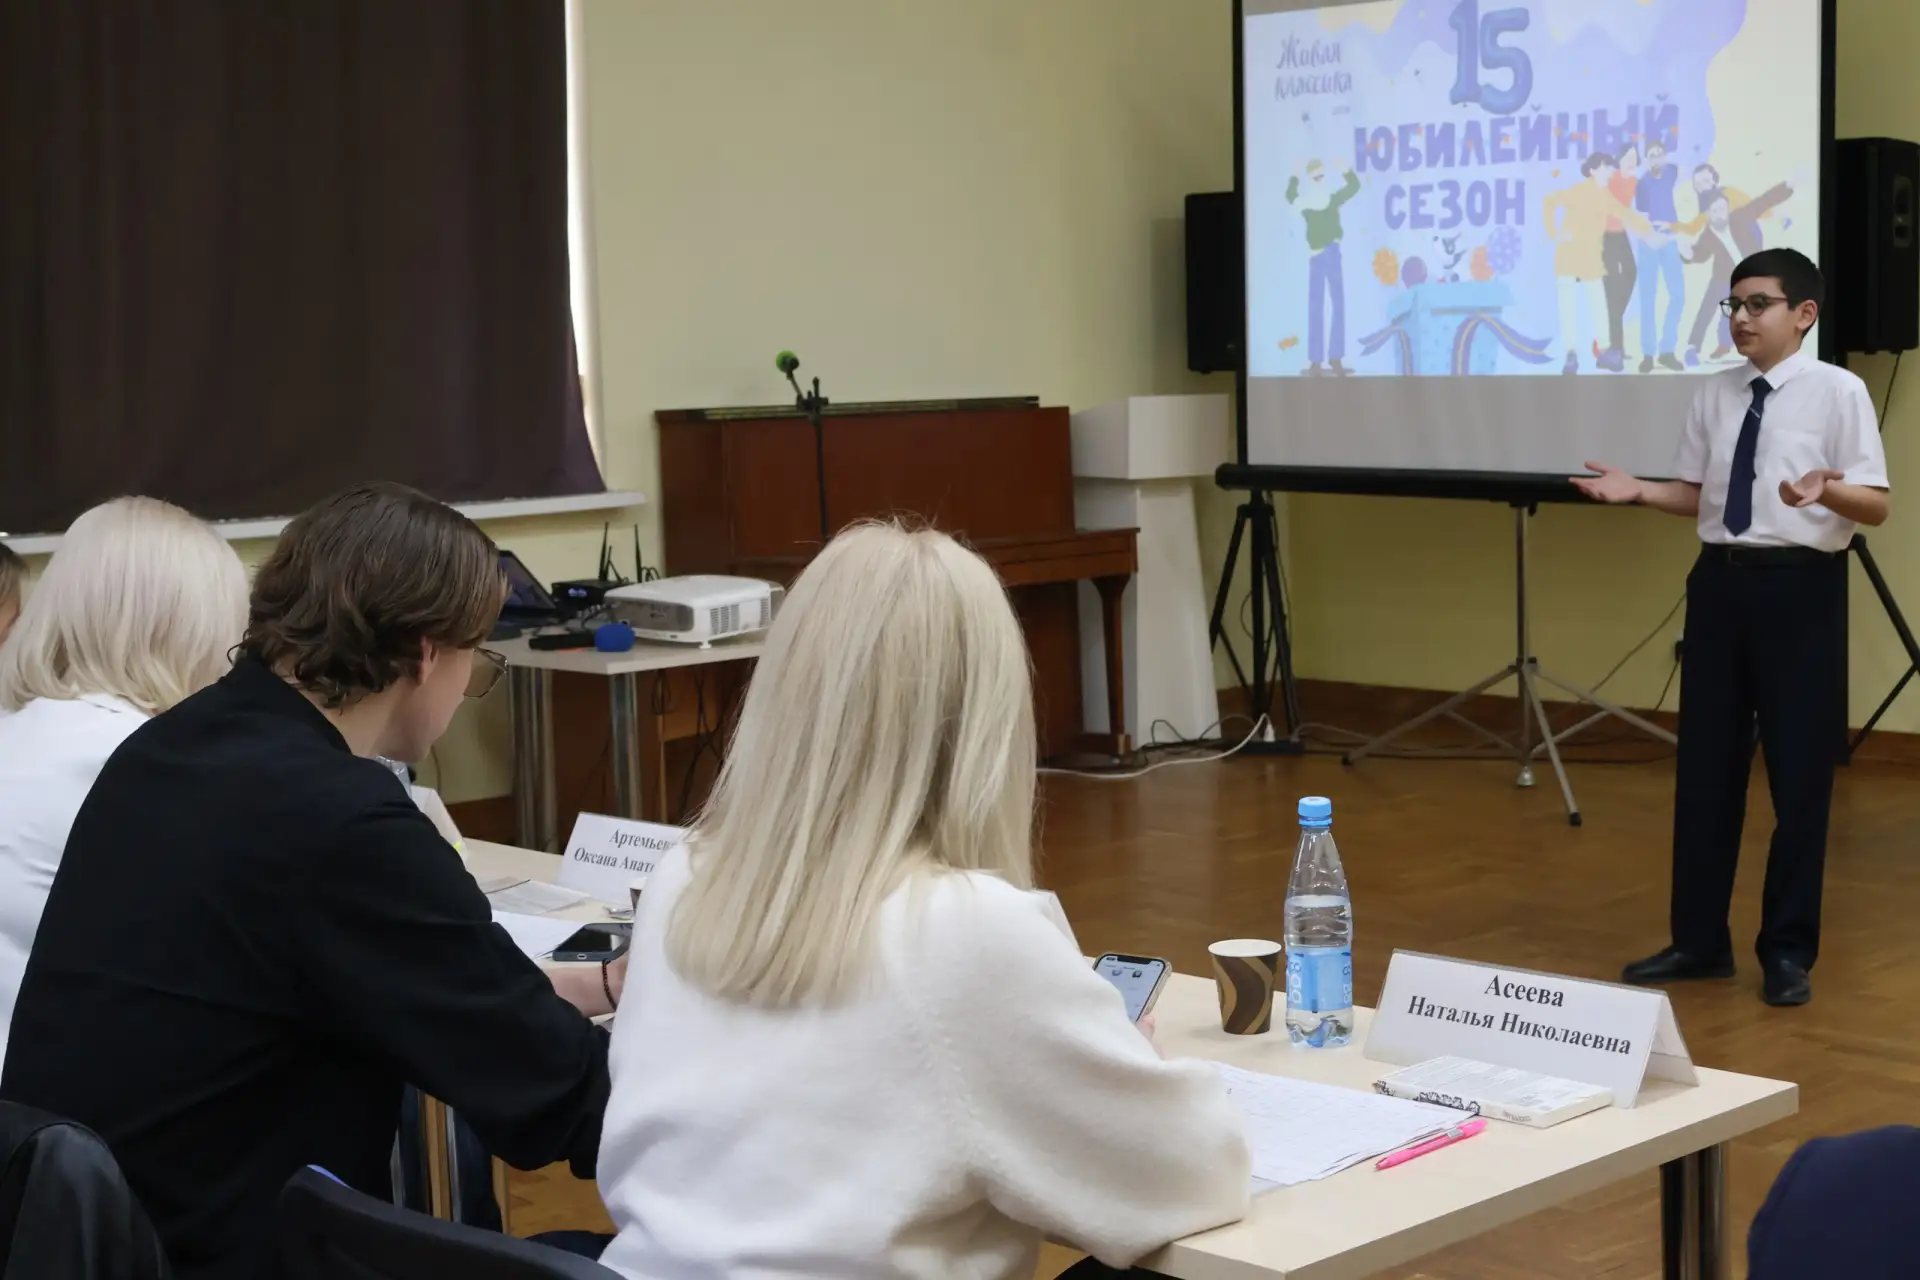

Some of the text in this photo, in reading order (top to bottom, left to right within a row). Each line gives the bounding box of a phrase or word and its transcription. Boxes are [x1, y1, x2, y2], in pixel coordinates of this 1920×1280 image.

[1449, 0, 1533, 115] 15
[1354, 93, 1679, 173] ЮБИЛЕЙНЫЙ
[1384, 178, 1525, 231] СЕЗОН
[574, 847, 655, 873] Оксана Анат
[1484, 974, 1565, 1008] Асеева
[1407, 995, 1632, 1055] Наталья Николаевна
